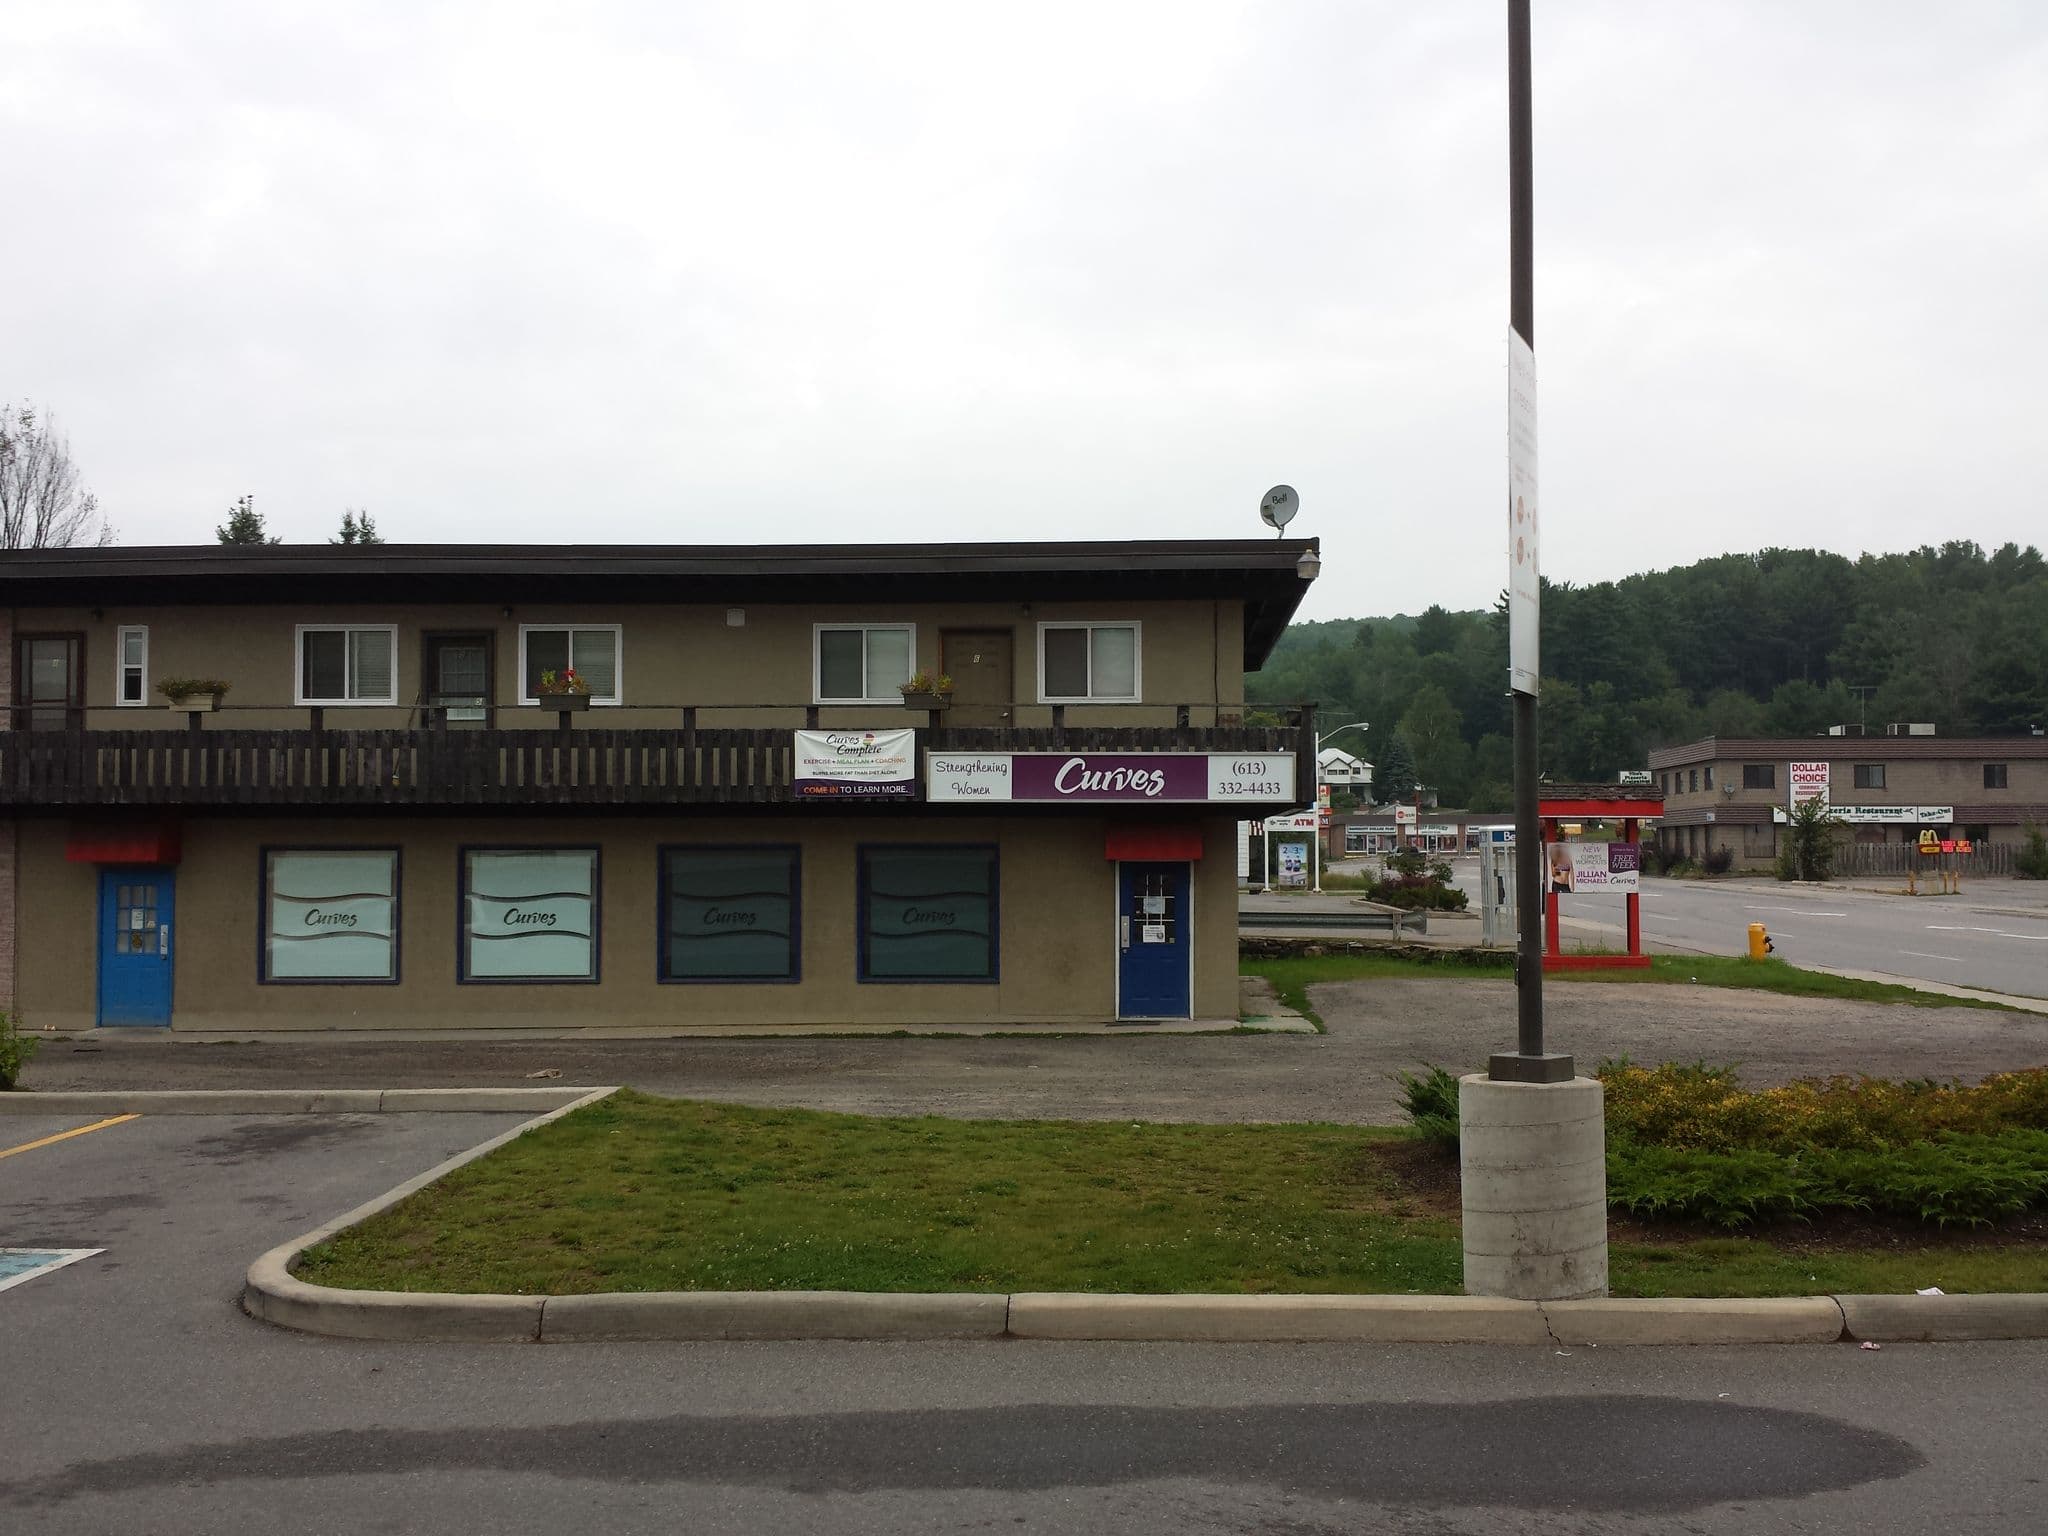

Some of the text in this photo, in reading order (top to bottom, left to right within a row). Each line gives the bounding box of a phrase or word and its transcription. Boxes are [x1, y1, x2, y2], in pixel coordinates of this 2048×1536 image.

[1272, 492, 1287, 504] Bell
[826, 733, 860, 745] Curves
[836, 744, 882, 757] Complete
[935, 759, 1008, 776] Strengthening
[1231, 761, 1267, 776] (613)
[1054, 757, 1167, 796] Curves
[1792, 774, 1827, 782] CHOICE
[803, 786, 828, 794] COME
[829, 786, 839, 794] IN
[840, 786, 852, 794] TO
[881, 785, 909, 793] MORE.
[951, 782, 991, 795] Women
[1217, 781, 1282, 795] 332-4433
[1855, 807, 1903, 815] Restaurant
[1504, 831, 1516, 841] Be
[1613, 854, 1635, 862] FREE
[1611, 861, 1636, 869] WEEK
[1576, 870, 1607, 878] JILLIAN
[1610, 876, 1636, 885] Curves
[304, 908, 358, 927] Curves
[503, 908, 557, 926] Curves
[703, 907, 757, 926] Curves
[902, 907, 956, 926] Curves
